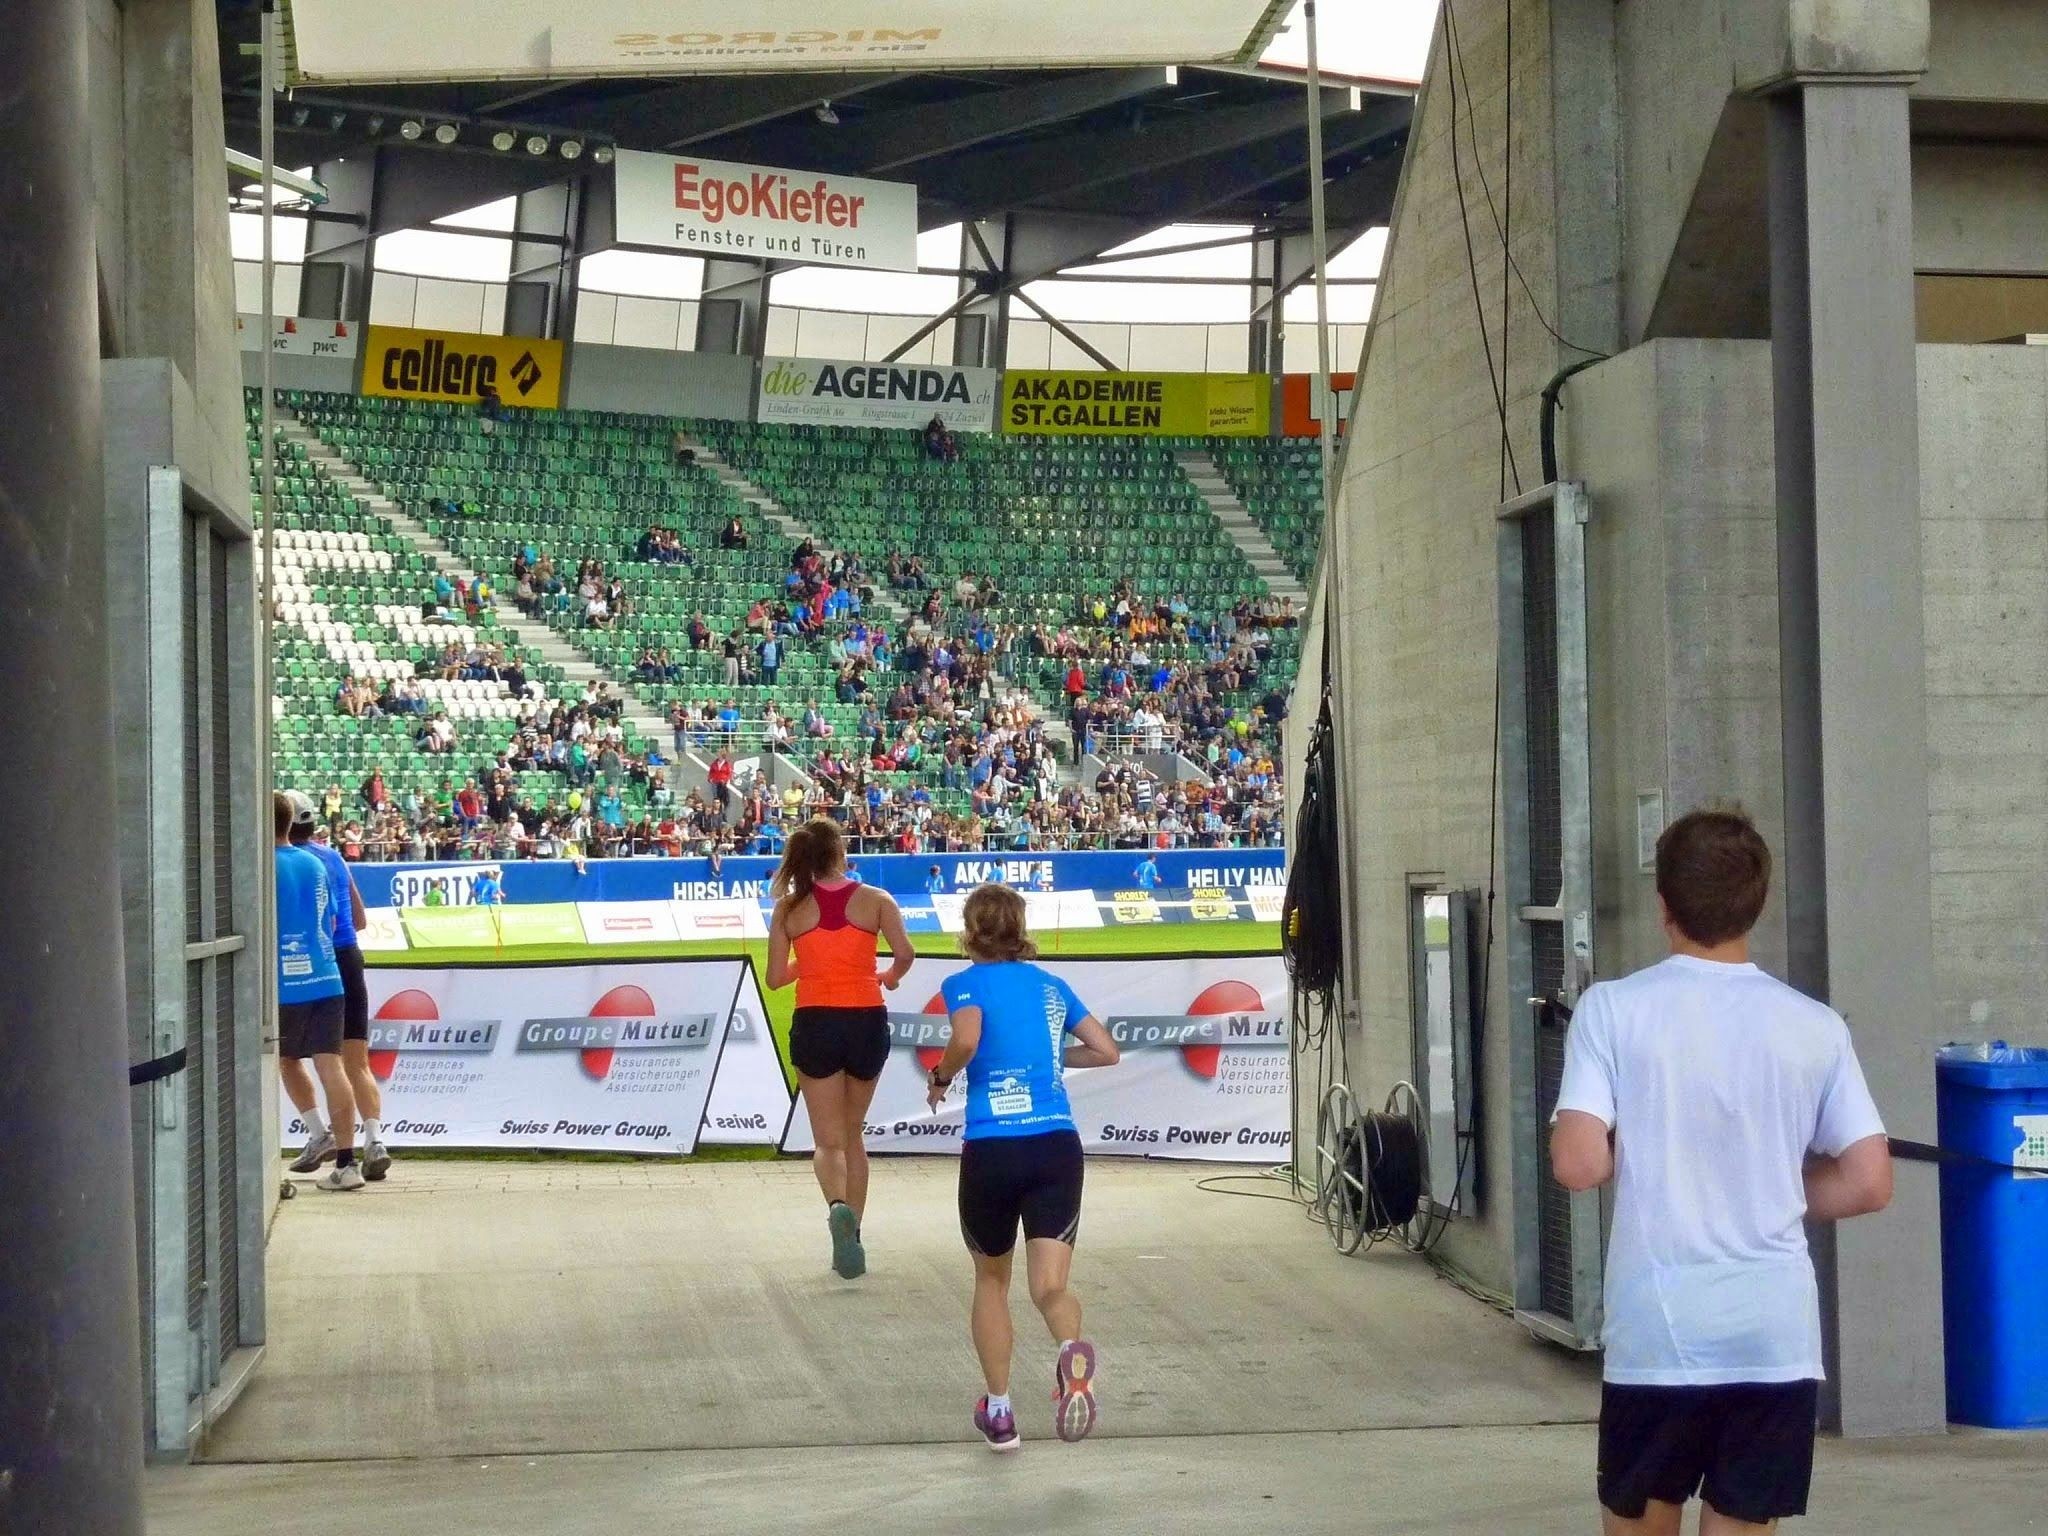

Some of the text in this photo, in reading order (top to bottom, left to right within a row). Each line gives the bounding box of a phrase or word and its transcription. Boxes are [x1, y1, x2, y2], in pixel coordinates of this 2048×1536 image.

[674, 163, 864, 228] EgoKiefer
[675, 224, 866, 259] Fenster und Türen
[312, 341, 338, 355] pwc
[383, 339, 497, 397] cellere
[1011, 379, 1163, 402] AKADEMIE
[1011, 404, 1162, 427] ST.GALLEN
[954, 860, 1054, 884] AKAEME
[1187, 868, 1245, 888] HELLY
[1192, 887, 1226, 898] SHORLEY
[406, 1024, 493, 1043] Mutuel
[526, 1022, 613, 1045] Groupe
[621, 1018, 708, 1041] Mutuel
[1111, 1016, 1290, 1043] Groupe Mut
[398, 1058, 464, 1070] Assurances
[614, 1056, 681, 1068] Assurances
[394, 1072, 483, 1084] Versicherungen
[610, 1069, 700, 1082] Versicherungen
[389, 1083, 468, 1093] Assicurazioni
[605, 1082, 686, 1093] Assicurazioni
[394, 1119, 449, 1136] Group.
[500, 1119, 671, 1140] Swiss Power Group.
[894, 1121, 962, 1137] Power
[1100, 1124, 1291, 1147] Swiss Power Group
